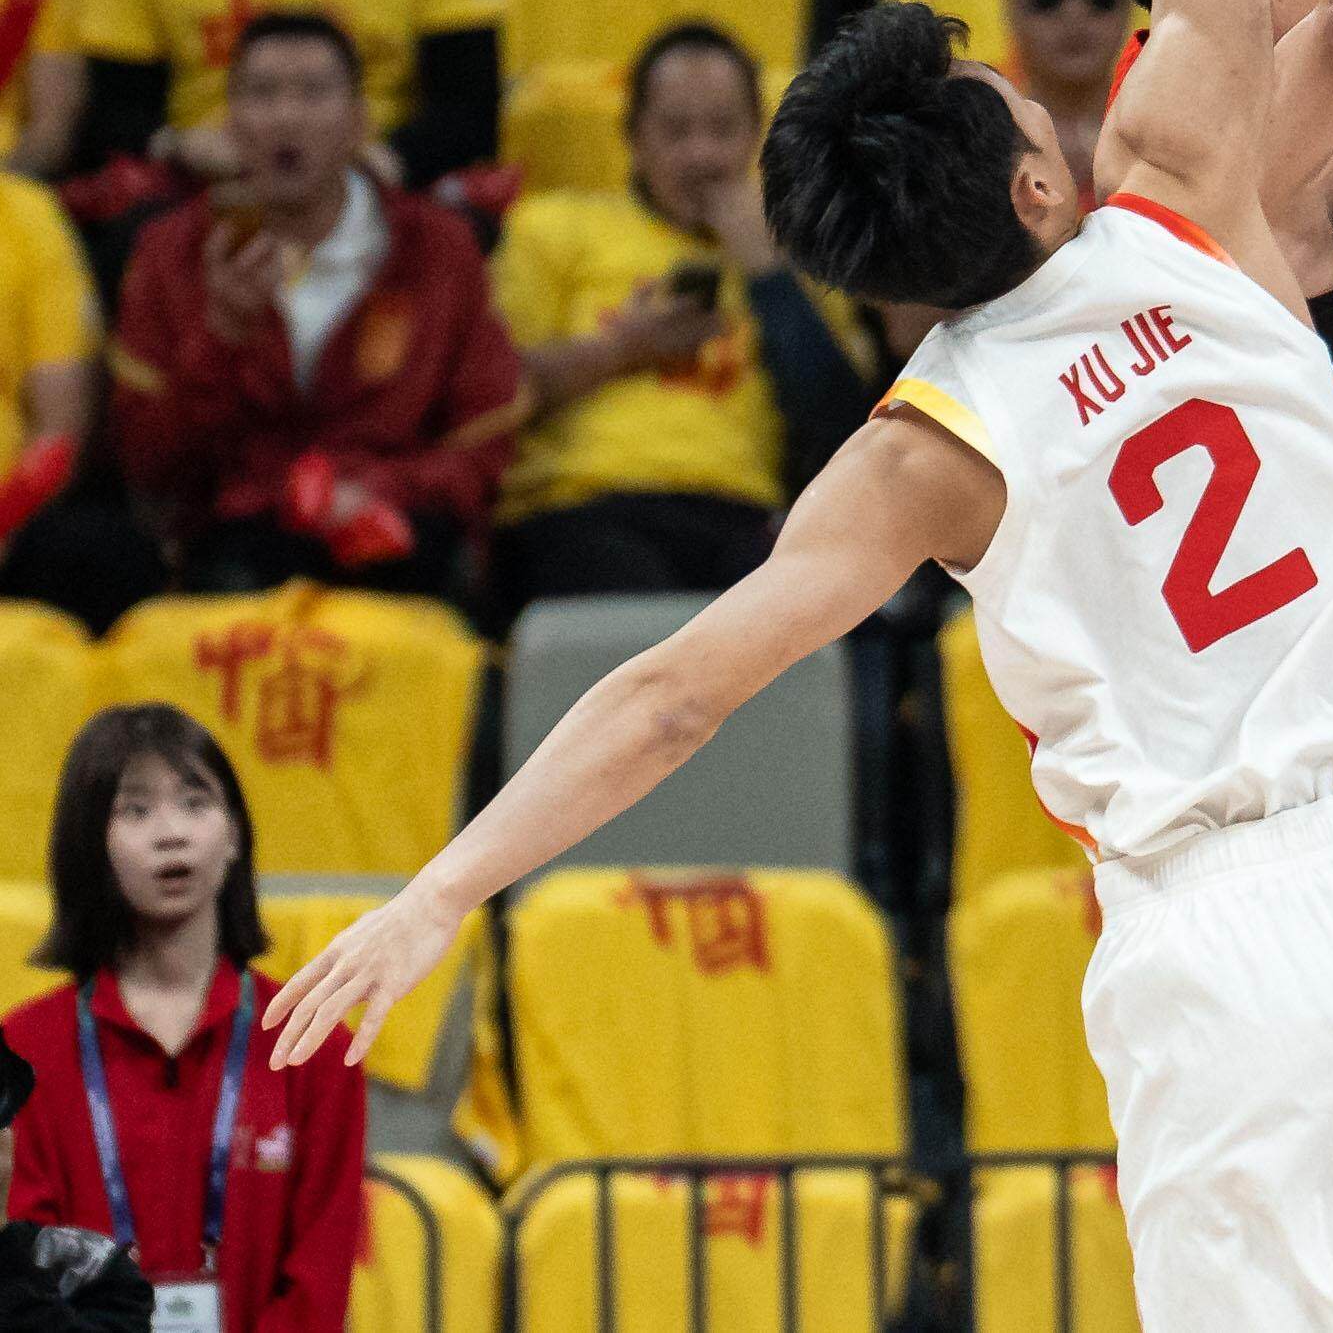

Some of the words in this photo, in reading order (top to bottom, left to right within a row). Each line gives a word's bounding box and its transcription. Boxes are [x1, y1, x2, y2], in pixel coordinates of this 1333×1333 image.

[1058, 343, 1126, 427] XU
[1120, 305, 1193, 377] JIE
[1107, 397, 1319, 654] 2
